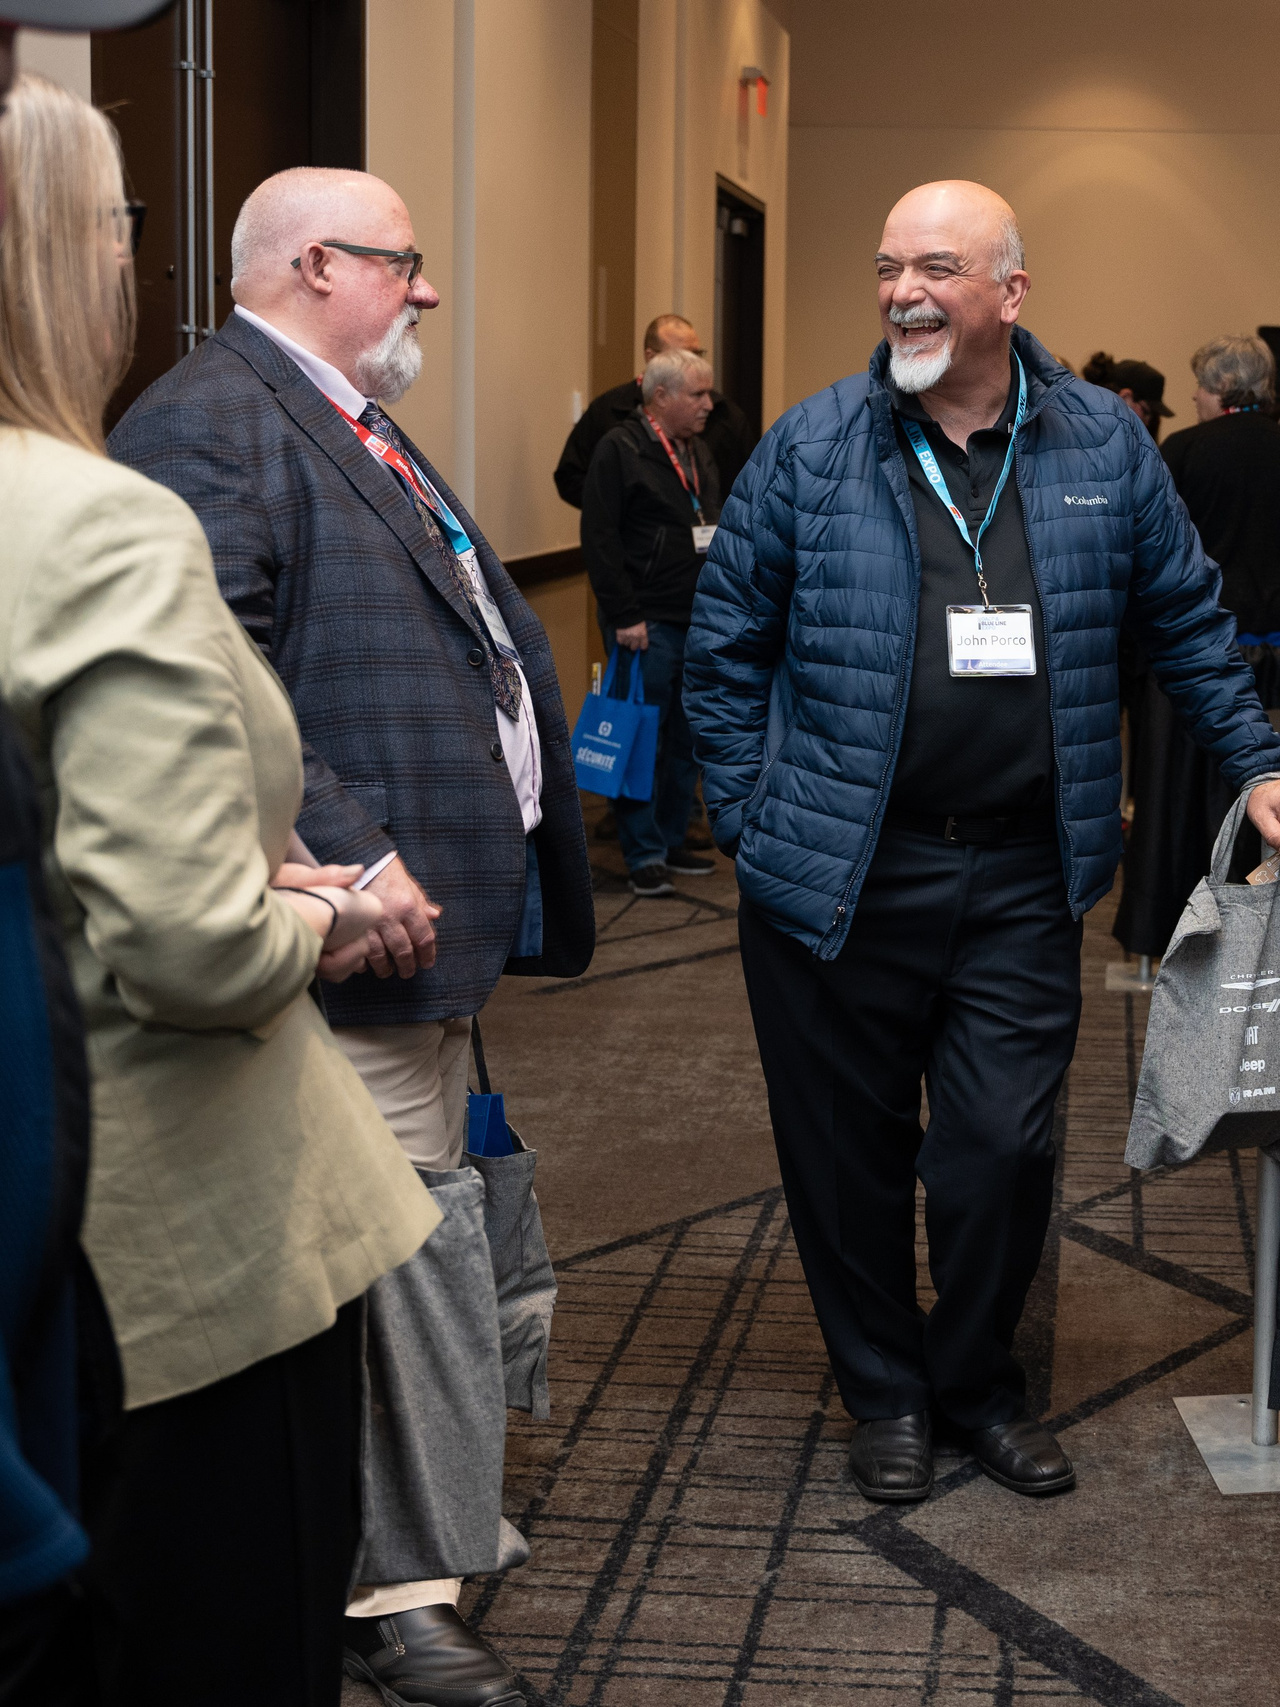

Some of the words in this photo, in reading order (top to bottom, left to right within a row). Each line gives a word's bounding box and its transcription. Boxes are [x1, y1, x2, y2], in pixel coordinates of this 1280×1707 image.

[918, 450, 942, 484] EXPO
[1072, 495, 1108, 506] Columbia
[957, 635, 987, 646] John
[991, 635, 1027, 646] Porco
[1230, 970, 1274, 980] CHRER
[1239, 1058, 1265, 1073] Jeep
[1242, 1086, 1276, 1098] RAM
